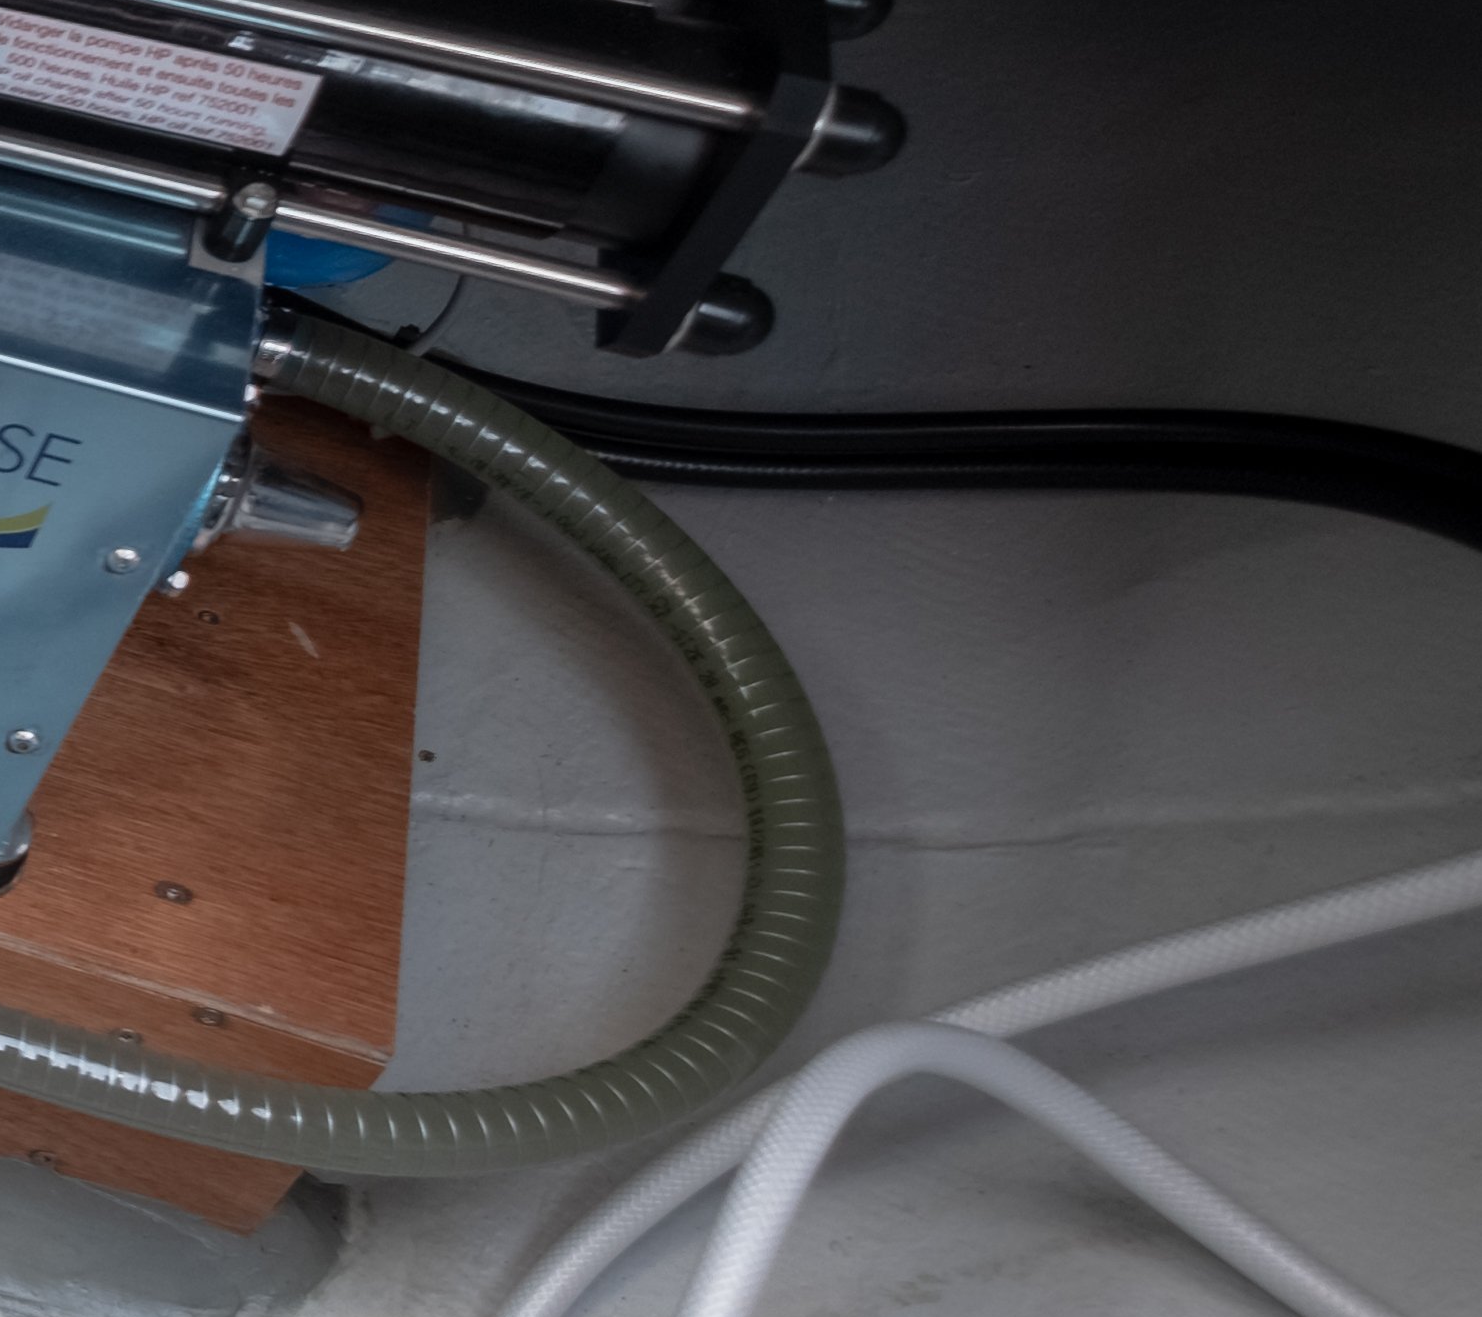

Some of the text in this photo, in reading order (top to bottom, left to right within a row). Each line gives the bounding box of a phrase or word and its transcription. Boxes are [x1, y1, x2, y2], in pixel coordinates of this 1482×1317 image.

[6, 51, 33, 67] 500
[98, 72, 140, 92] Huile
[141, 82, 170, 98] HP
[10, 35, 132, 73] fonctionnement
[135, 64, 154, 77] et
[154, 67, 214, 90] ensuite
[216, 81, 268, 102] toutes
[271, 92, 296, 108] les
[66, 29, 82, 43] la
[84, 35, 141, 58] pompe
[144, 45, 172, 62] HP
[222, 62, 245, 78] 50
[247, 67, 303, 91] heures
[31, 74, 92, 97] change
[133, 97, 154, 111] 50
[156, 102, 202, 121] hours
